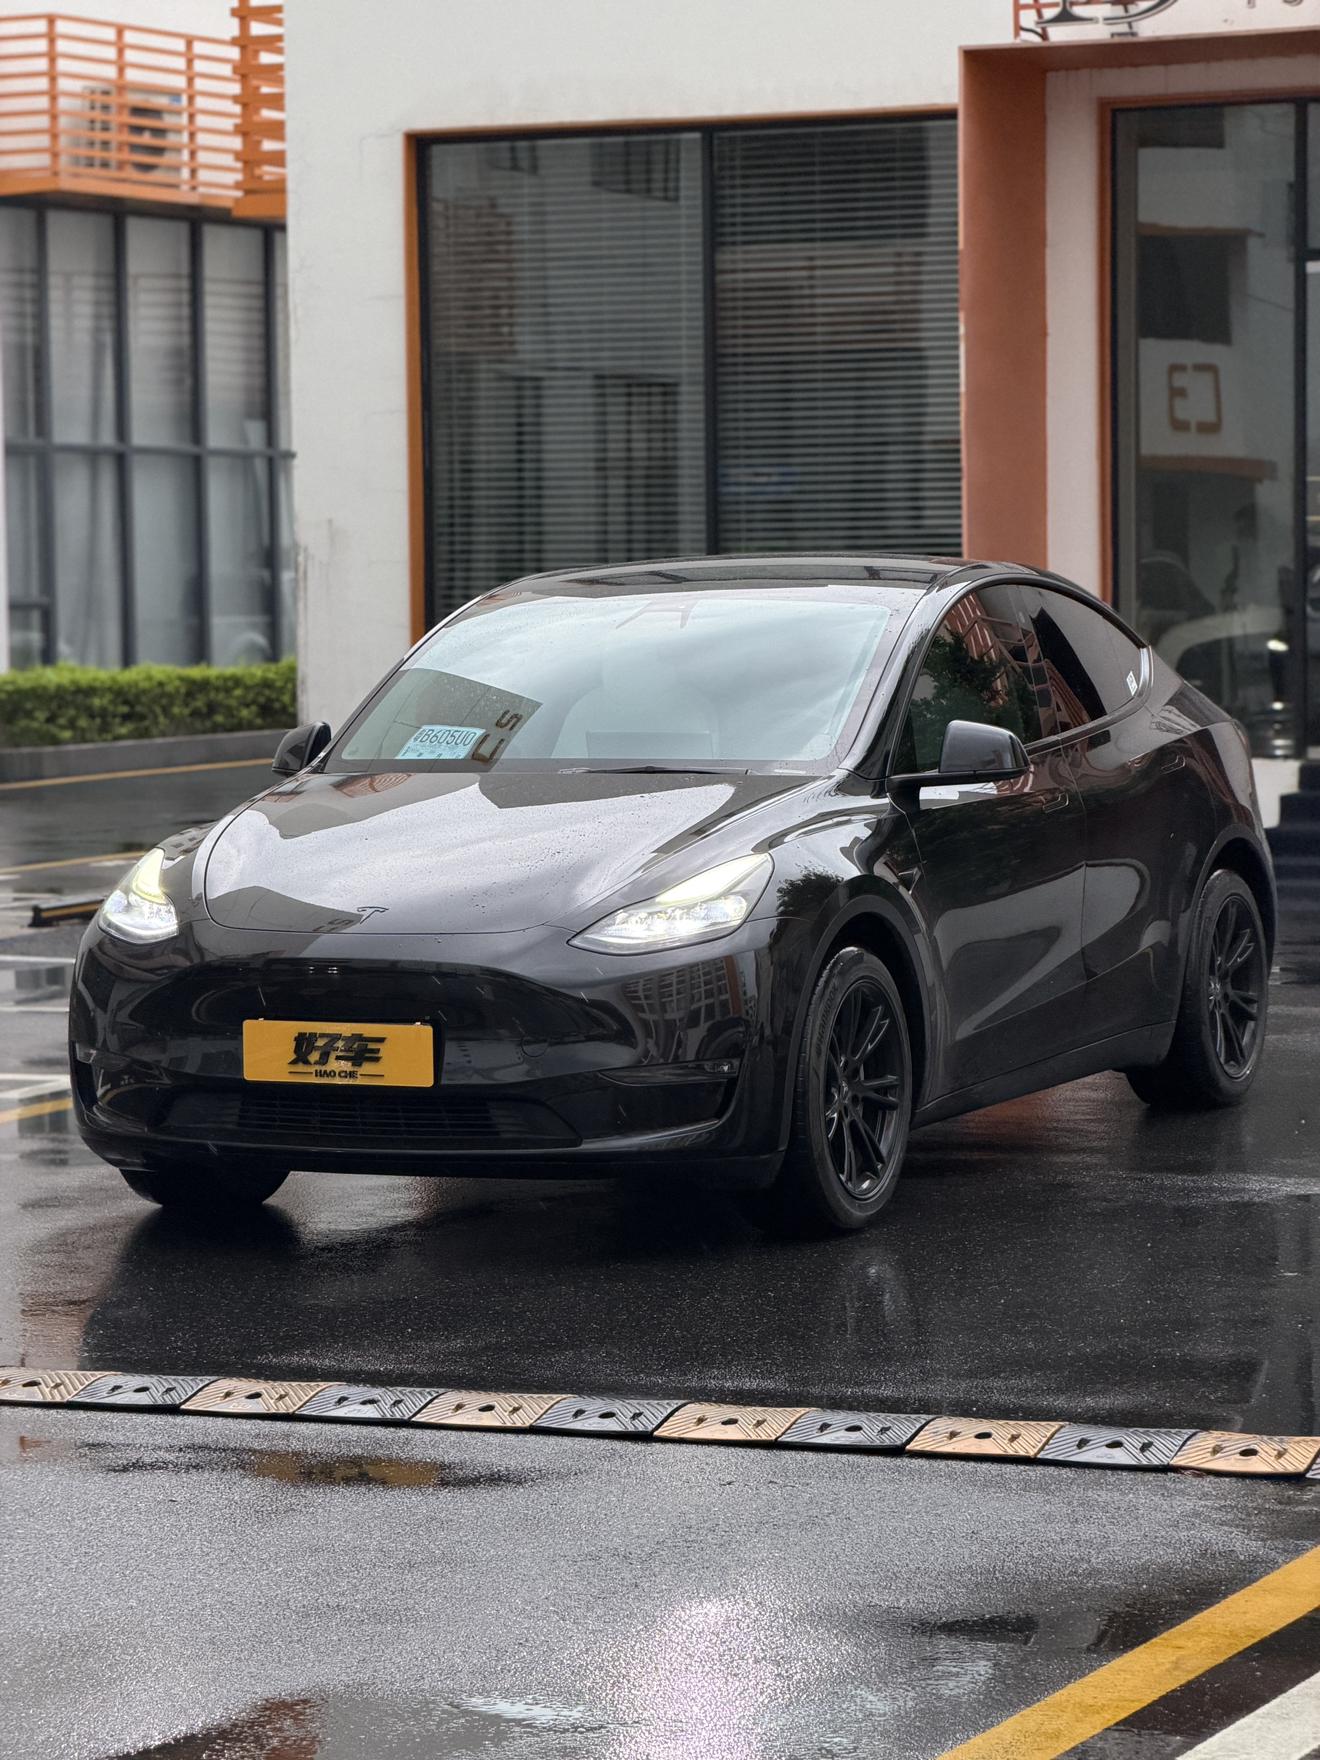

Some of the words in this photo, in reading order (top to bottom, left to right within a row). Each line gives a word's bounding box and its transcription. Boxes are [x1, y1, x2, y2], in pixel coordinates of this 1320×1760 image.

[287, 1032, 387, 1067] 好车
[314, 1069, 337, 1079] HAO
[339, 1070, 359, 1080] CHE
